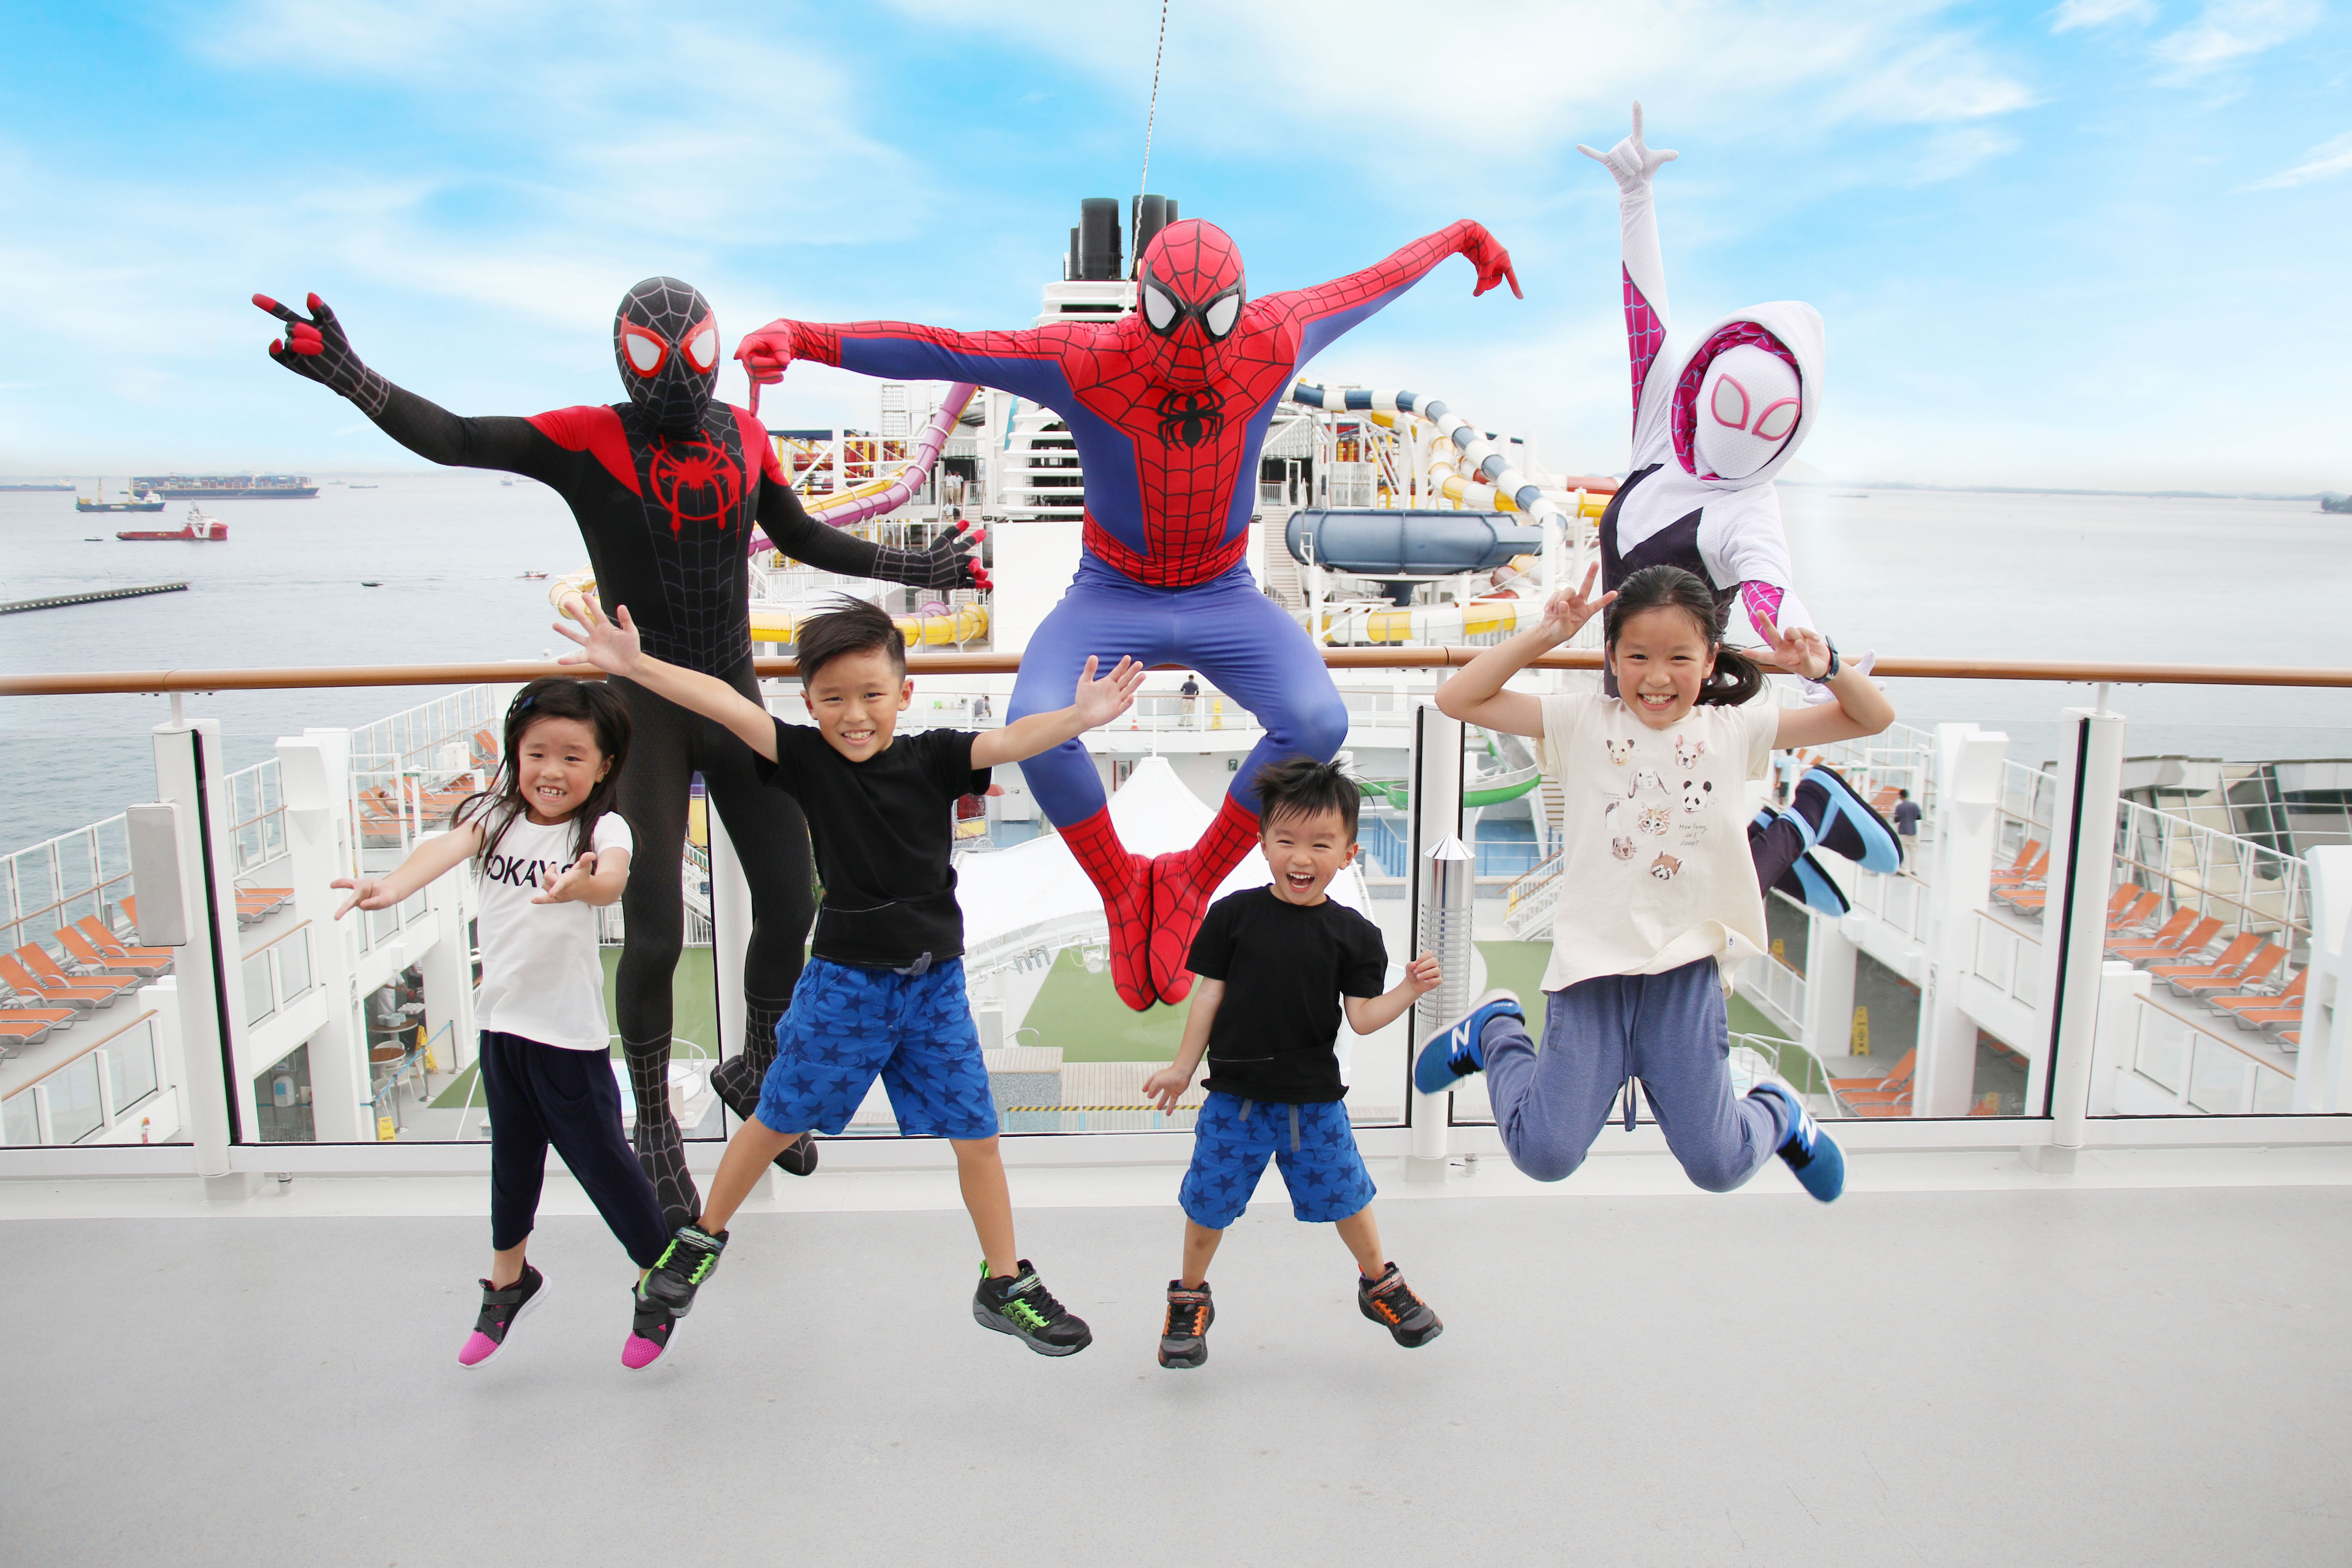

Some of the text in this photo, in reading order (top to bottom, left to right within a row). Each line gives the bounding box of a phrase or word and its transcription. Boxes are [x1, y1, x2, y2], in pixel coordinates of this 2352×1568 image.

[1694, 823, 1708, 835] long
[1680, 839, 1700, 848] sleep?
[1451, 1018, 1471, 1054] N
